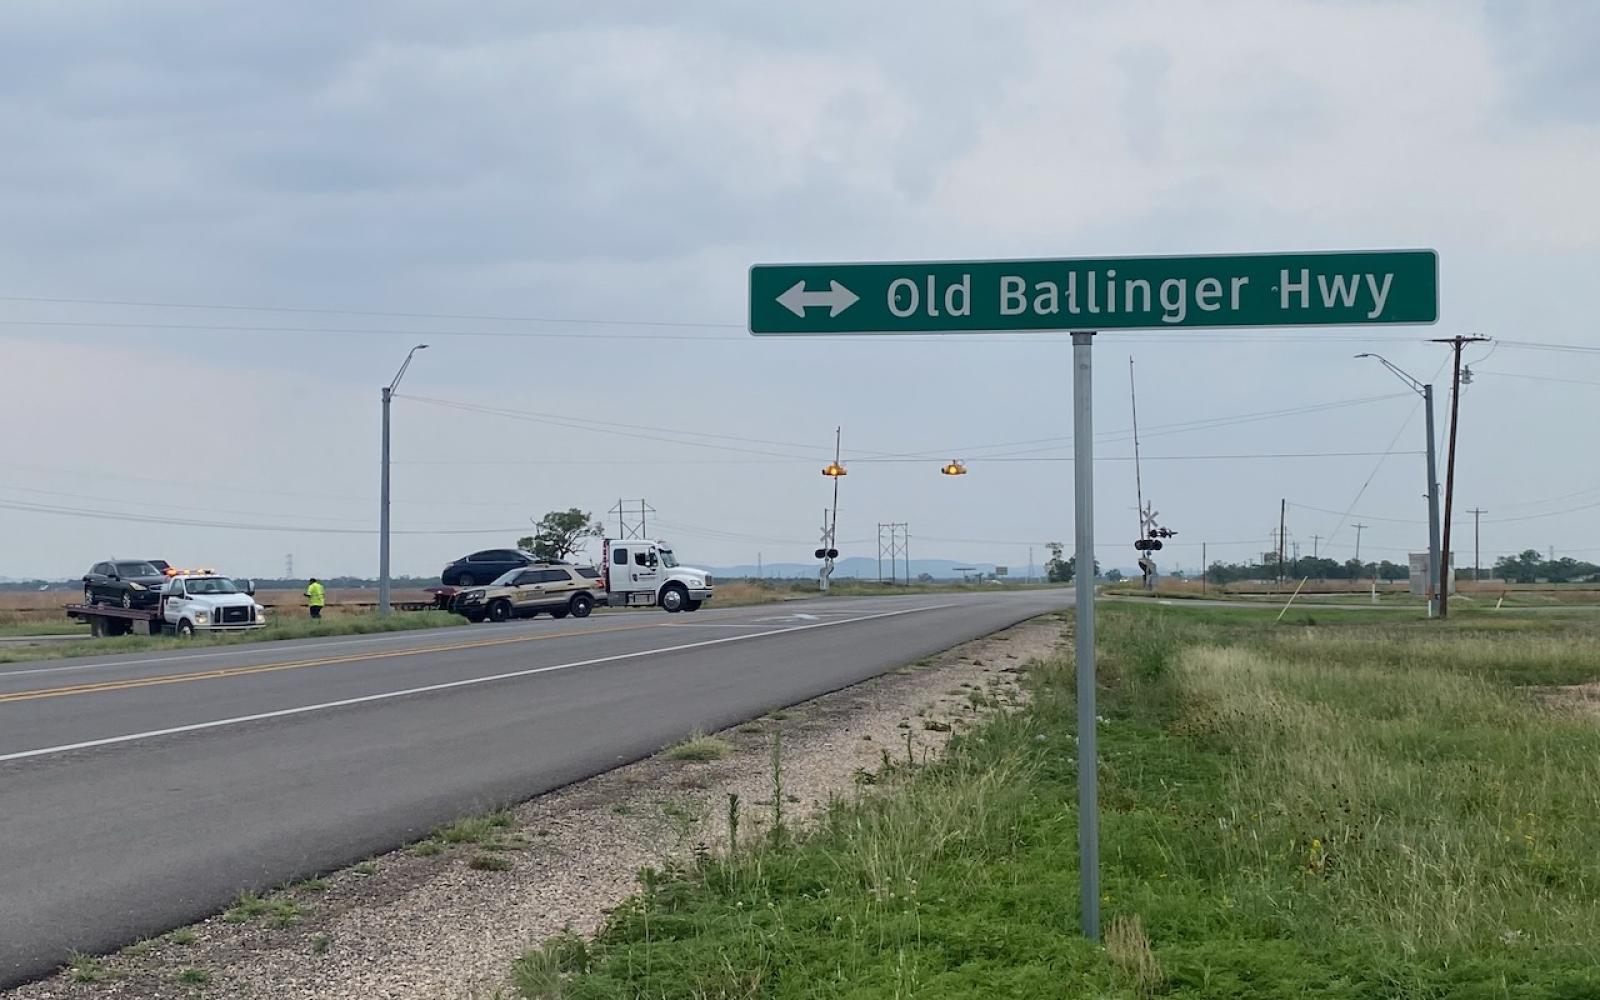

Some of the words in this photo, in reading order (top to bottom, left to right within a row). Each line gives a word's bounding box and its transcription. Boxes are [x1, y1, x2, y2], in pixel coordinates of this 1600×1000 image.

[887, 274, 971, 318] Old
[1000, 270, 1249, 323] Ballinger
[1280, 269, 1394, 319] Hwy
